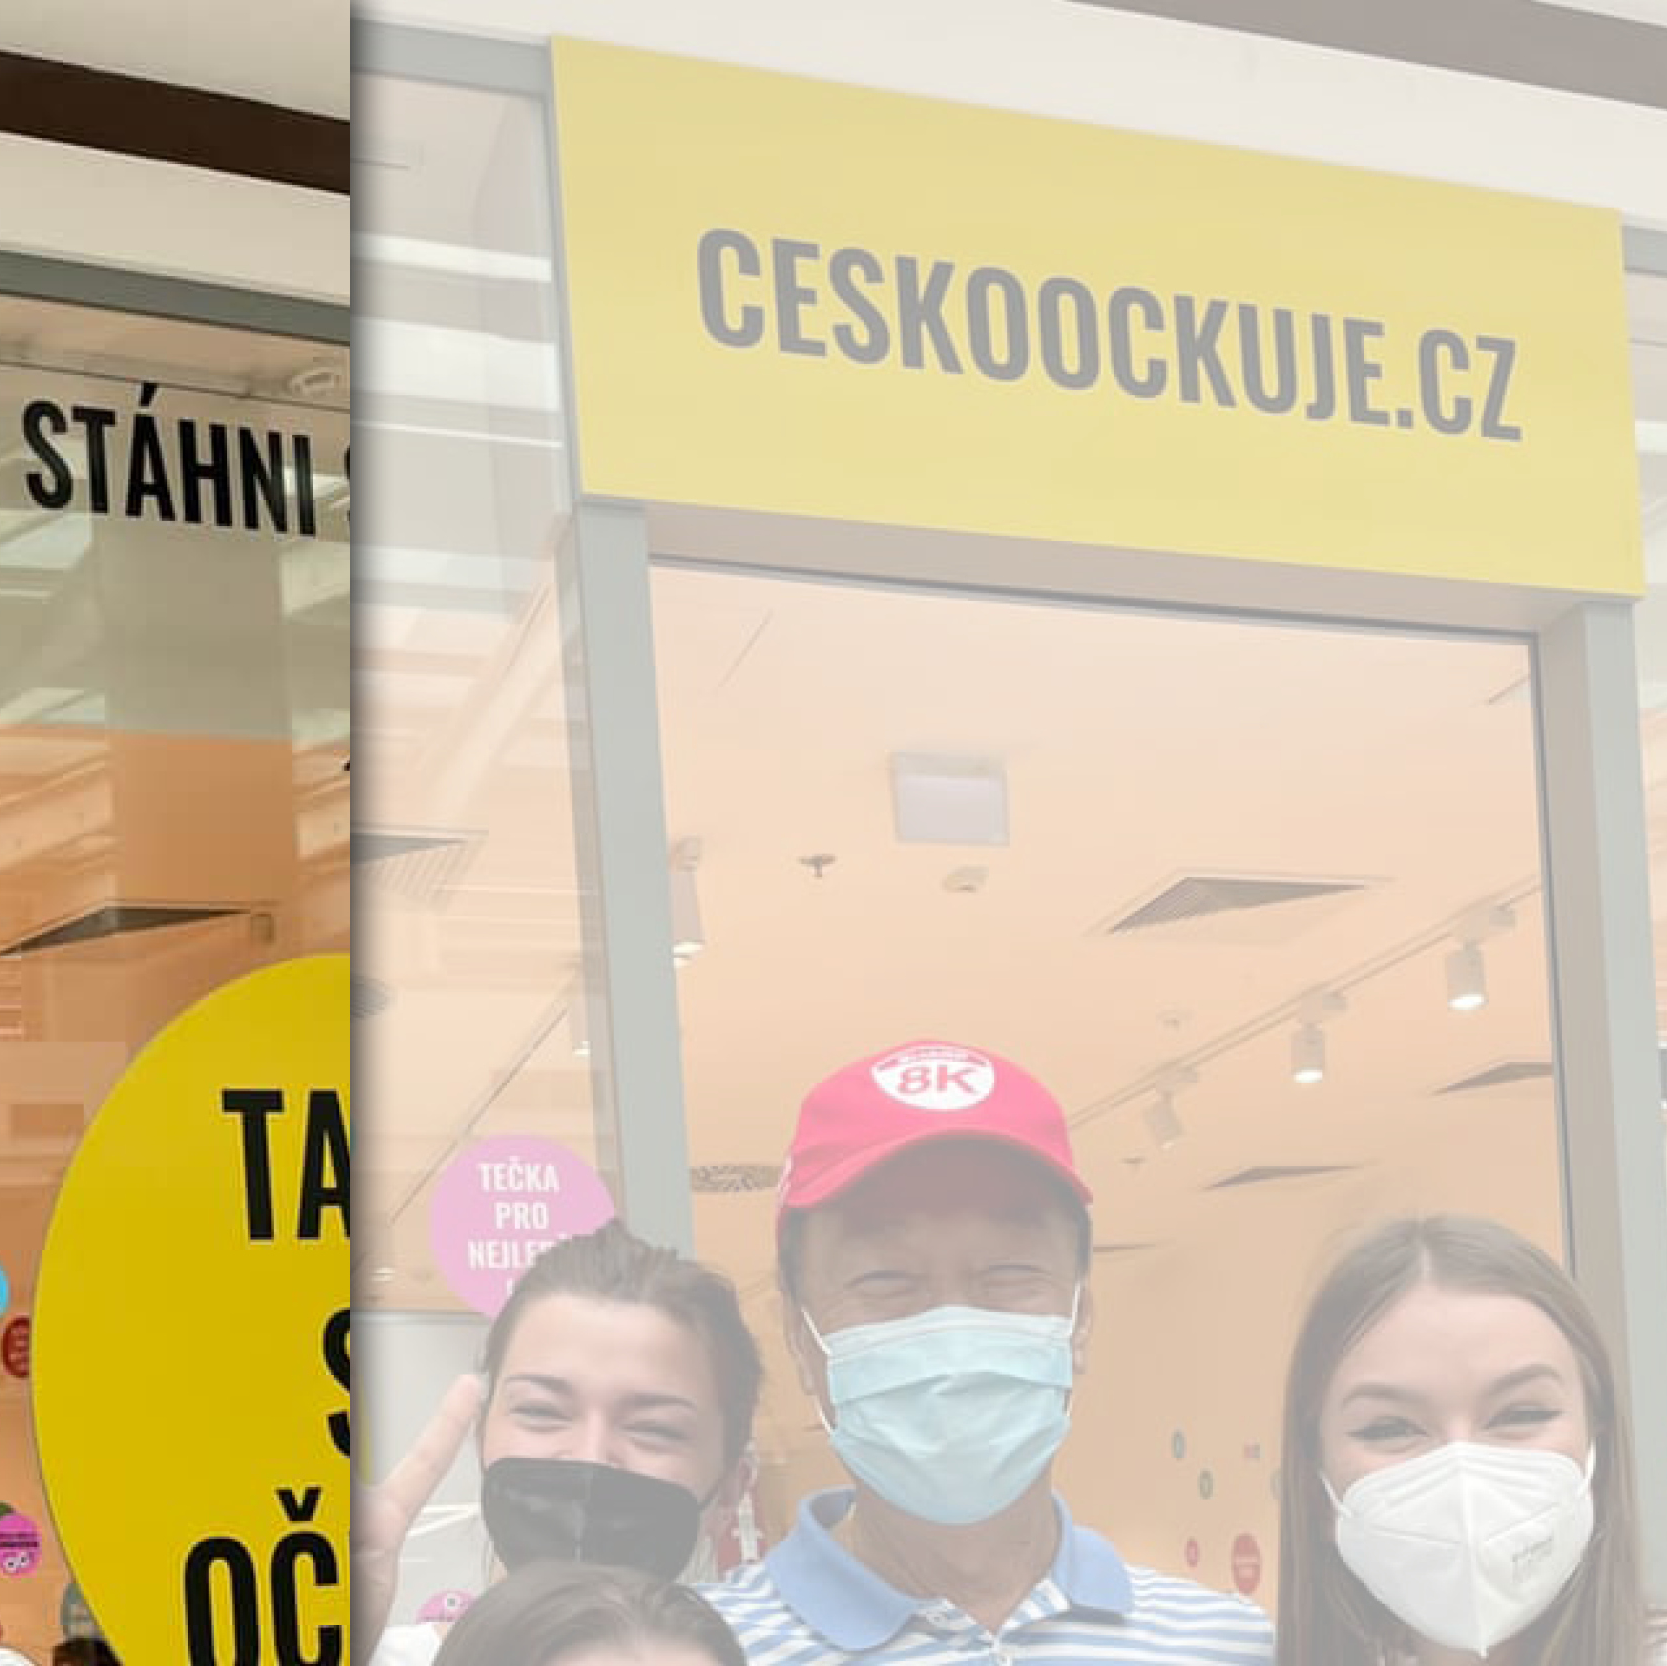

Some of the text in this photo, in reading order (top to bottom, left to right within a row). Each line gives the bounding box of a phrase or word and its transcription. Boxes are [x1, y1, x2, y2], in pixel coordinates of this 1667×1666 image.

[695, 227, 1522, 441] CESKOOCKUJE.CZ
[21, 382, 317, 537] STÁHNI
[222, 1088, 350, 1241] TA
[477, 1155, 561, 1192] TEČKA
[467, 1233, 567, 1269] NEJLE
[494, 1201, 549, 1229] PRO
